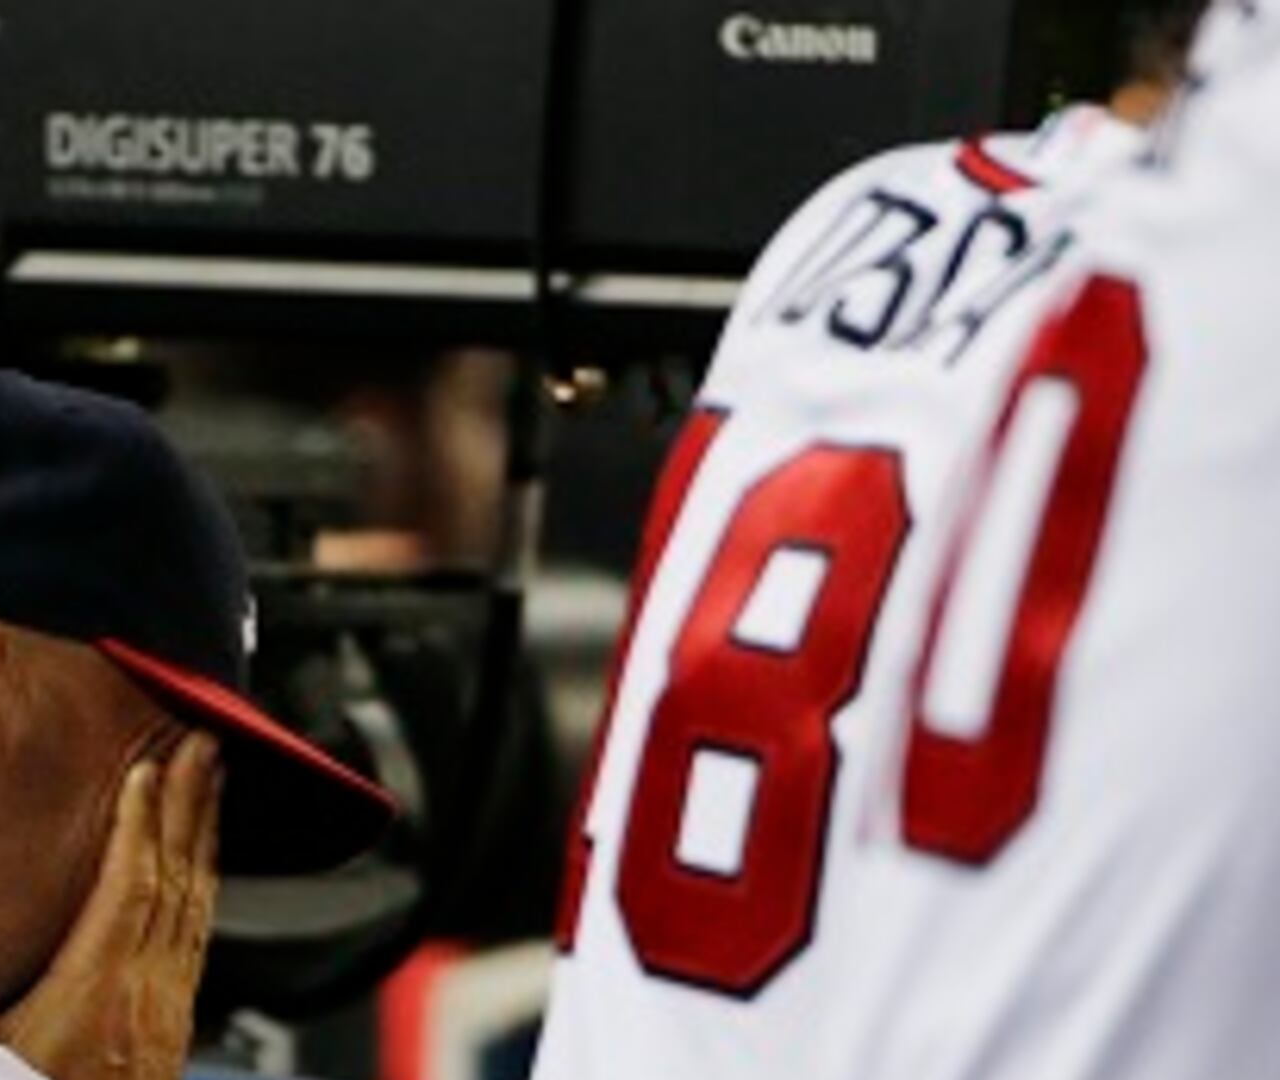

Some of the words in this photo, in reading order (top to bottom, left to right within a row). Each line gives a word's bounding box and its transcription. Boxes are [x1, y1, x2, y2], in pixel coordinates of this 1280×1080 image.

[719, 13, 876, 63] Canon
[45, 112, 300, 177] DIGISUPER
[310, 122, 375, 182] 76
[554, 405, 912, 1003] 8
